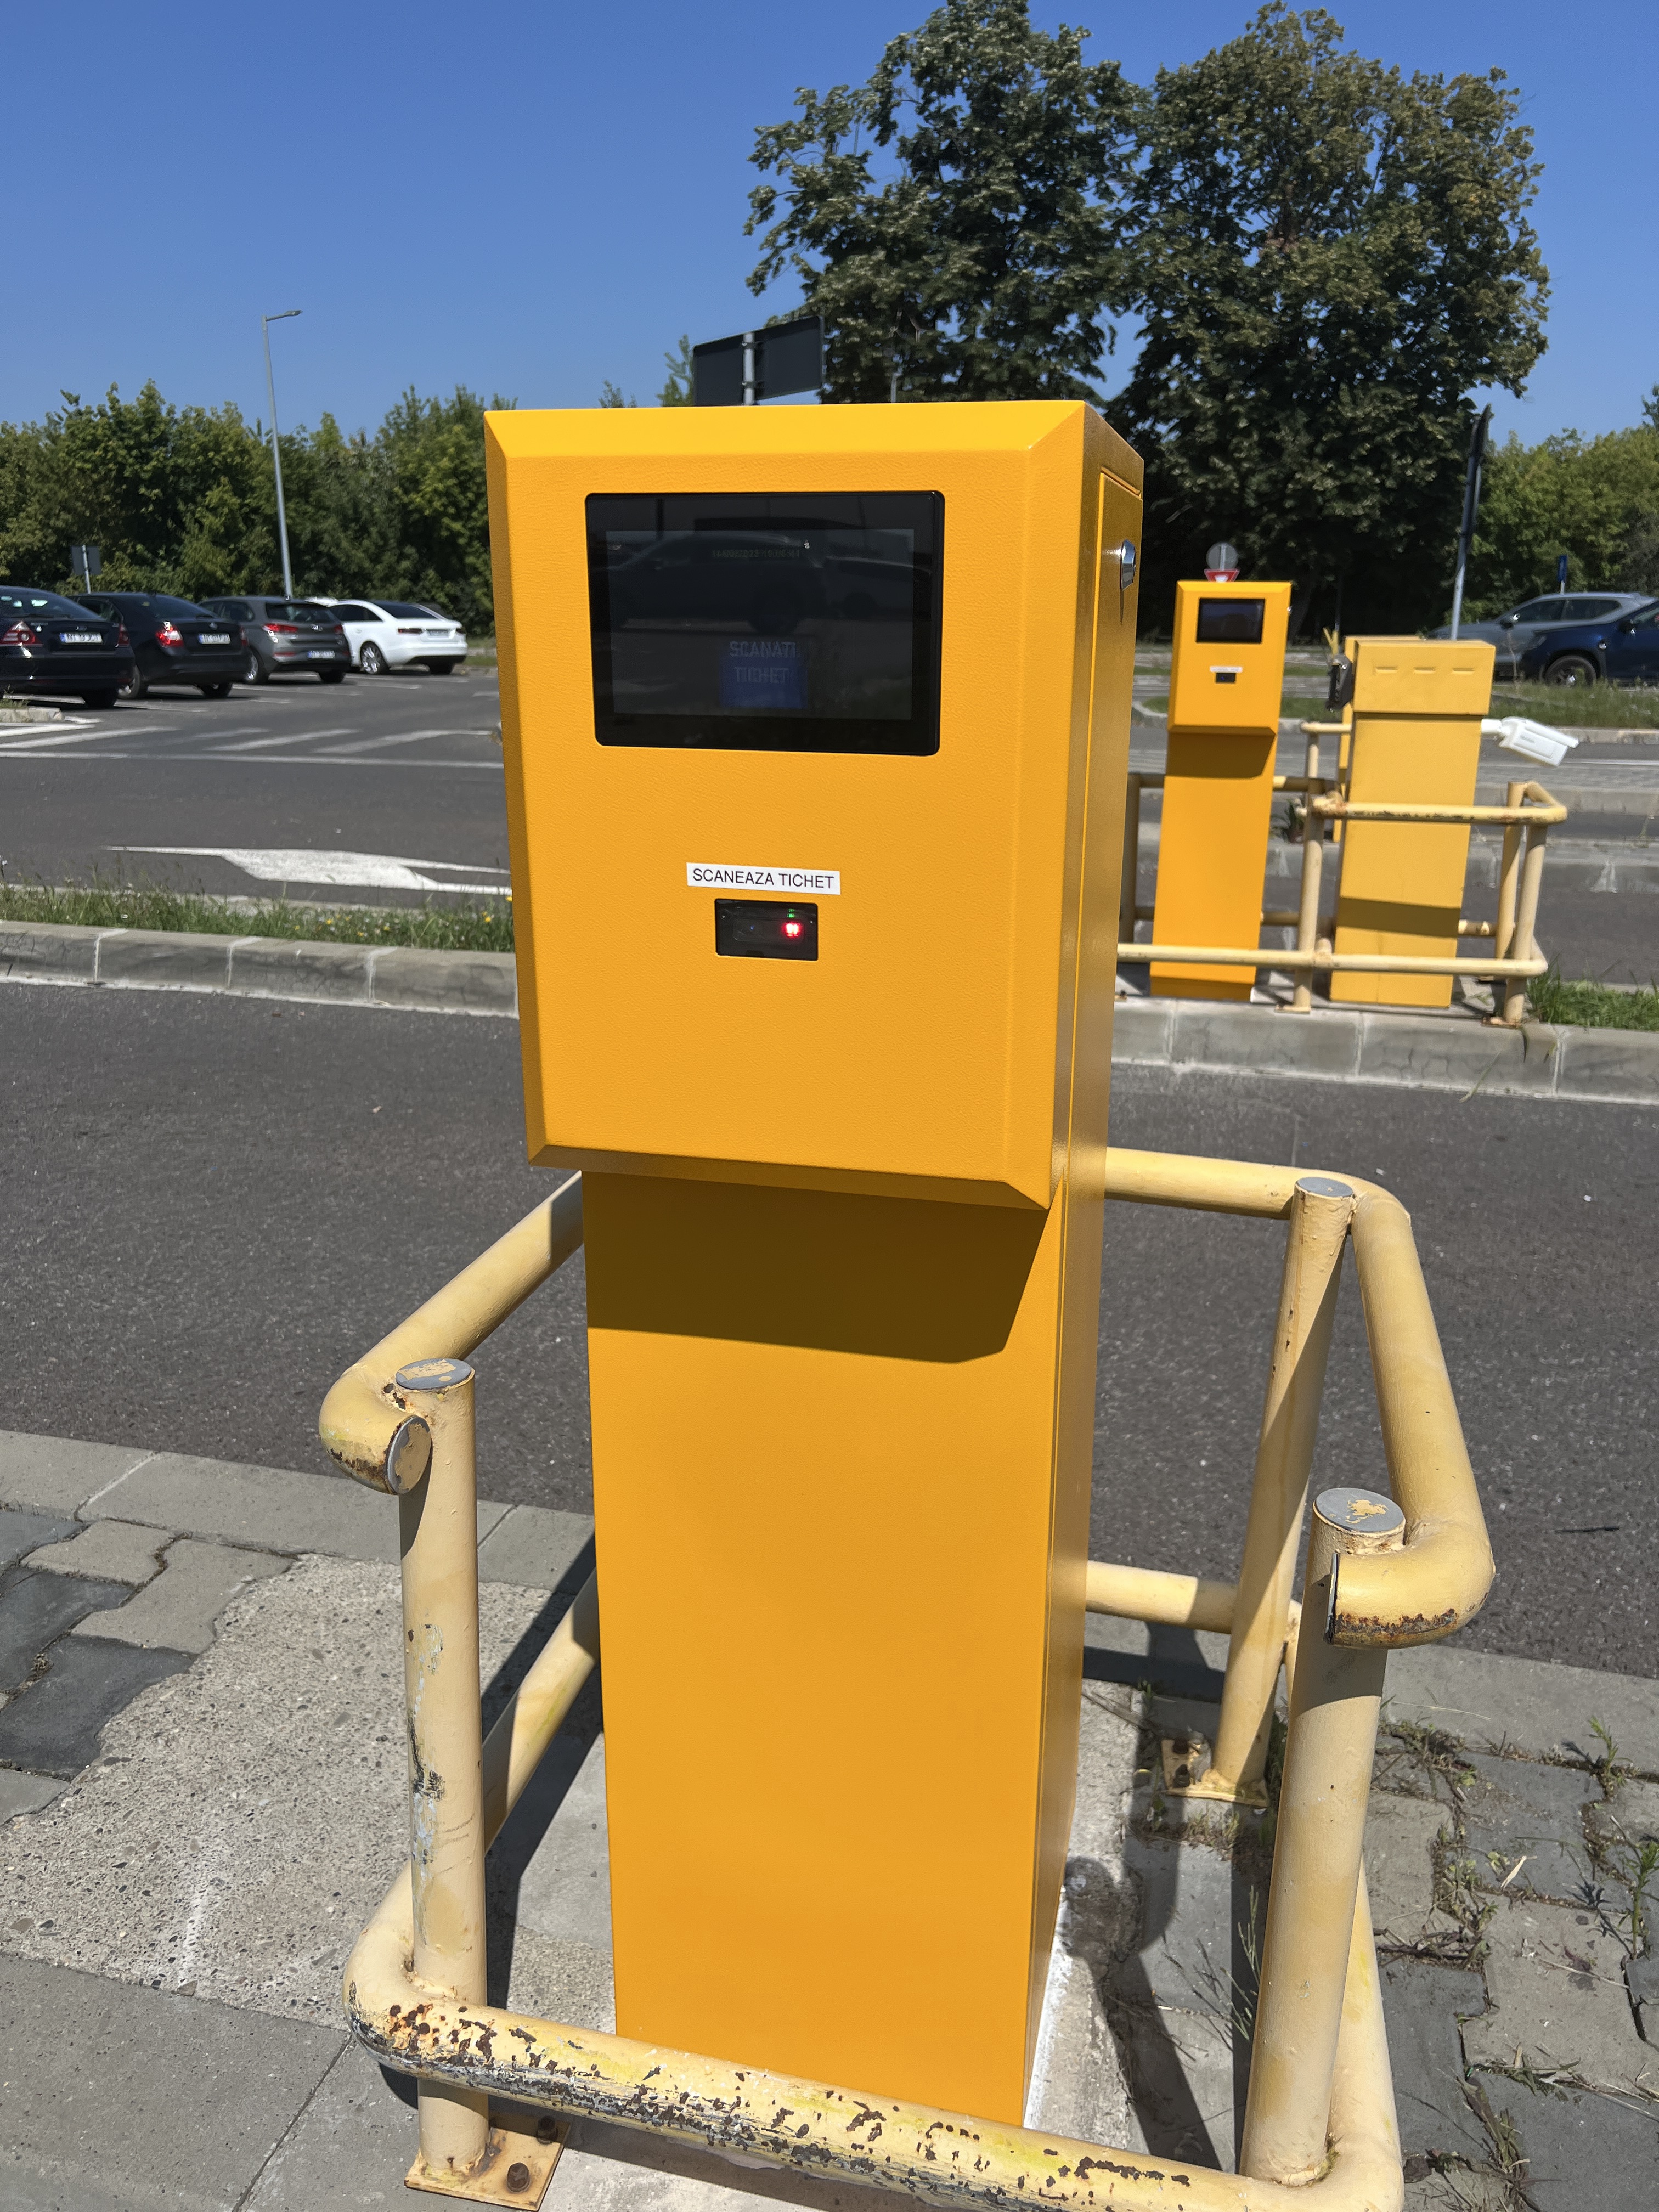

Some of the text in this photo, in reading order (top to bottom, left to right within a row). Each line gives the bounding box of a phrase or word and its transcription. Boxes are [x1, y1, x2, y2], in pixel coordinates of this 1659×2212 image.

[729, 641, 796, 658] SCANATI
[733, 667, 789, 684] TICHET
[693, 868, 834, 889] SCANEAZA TICHET
